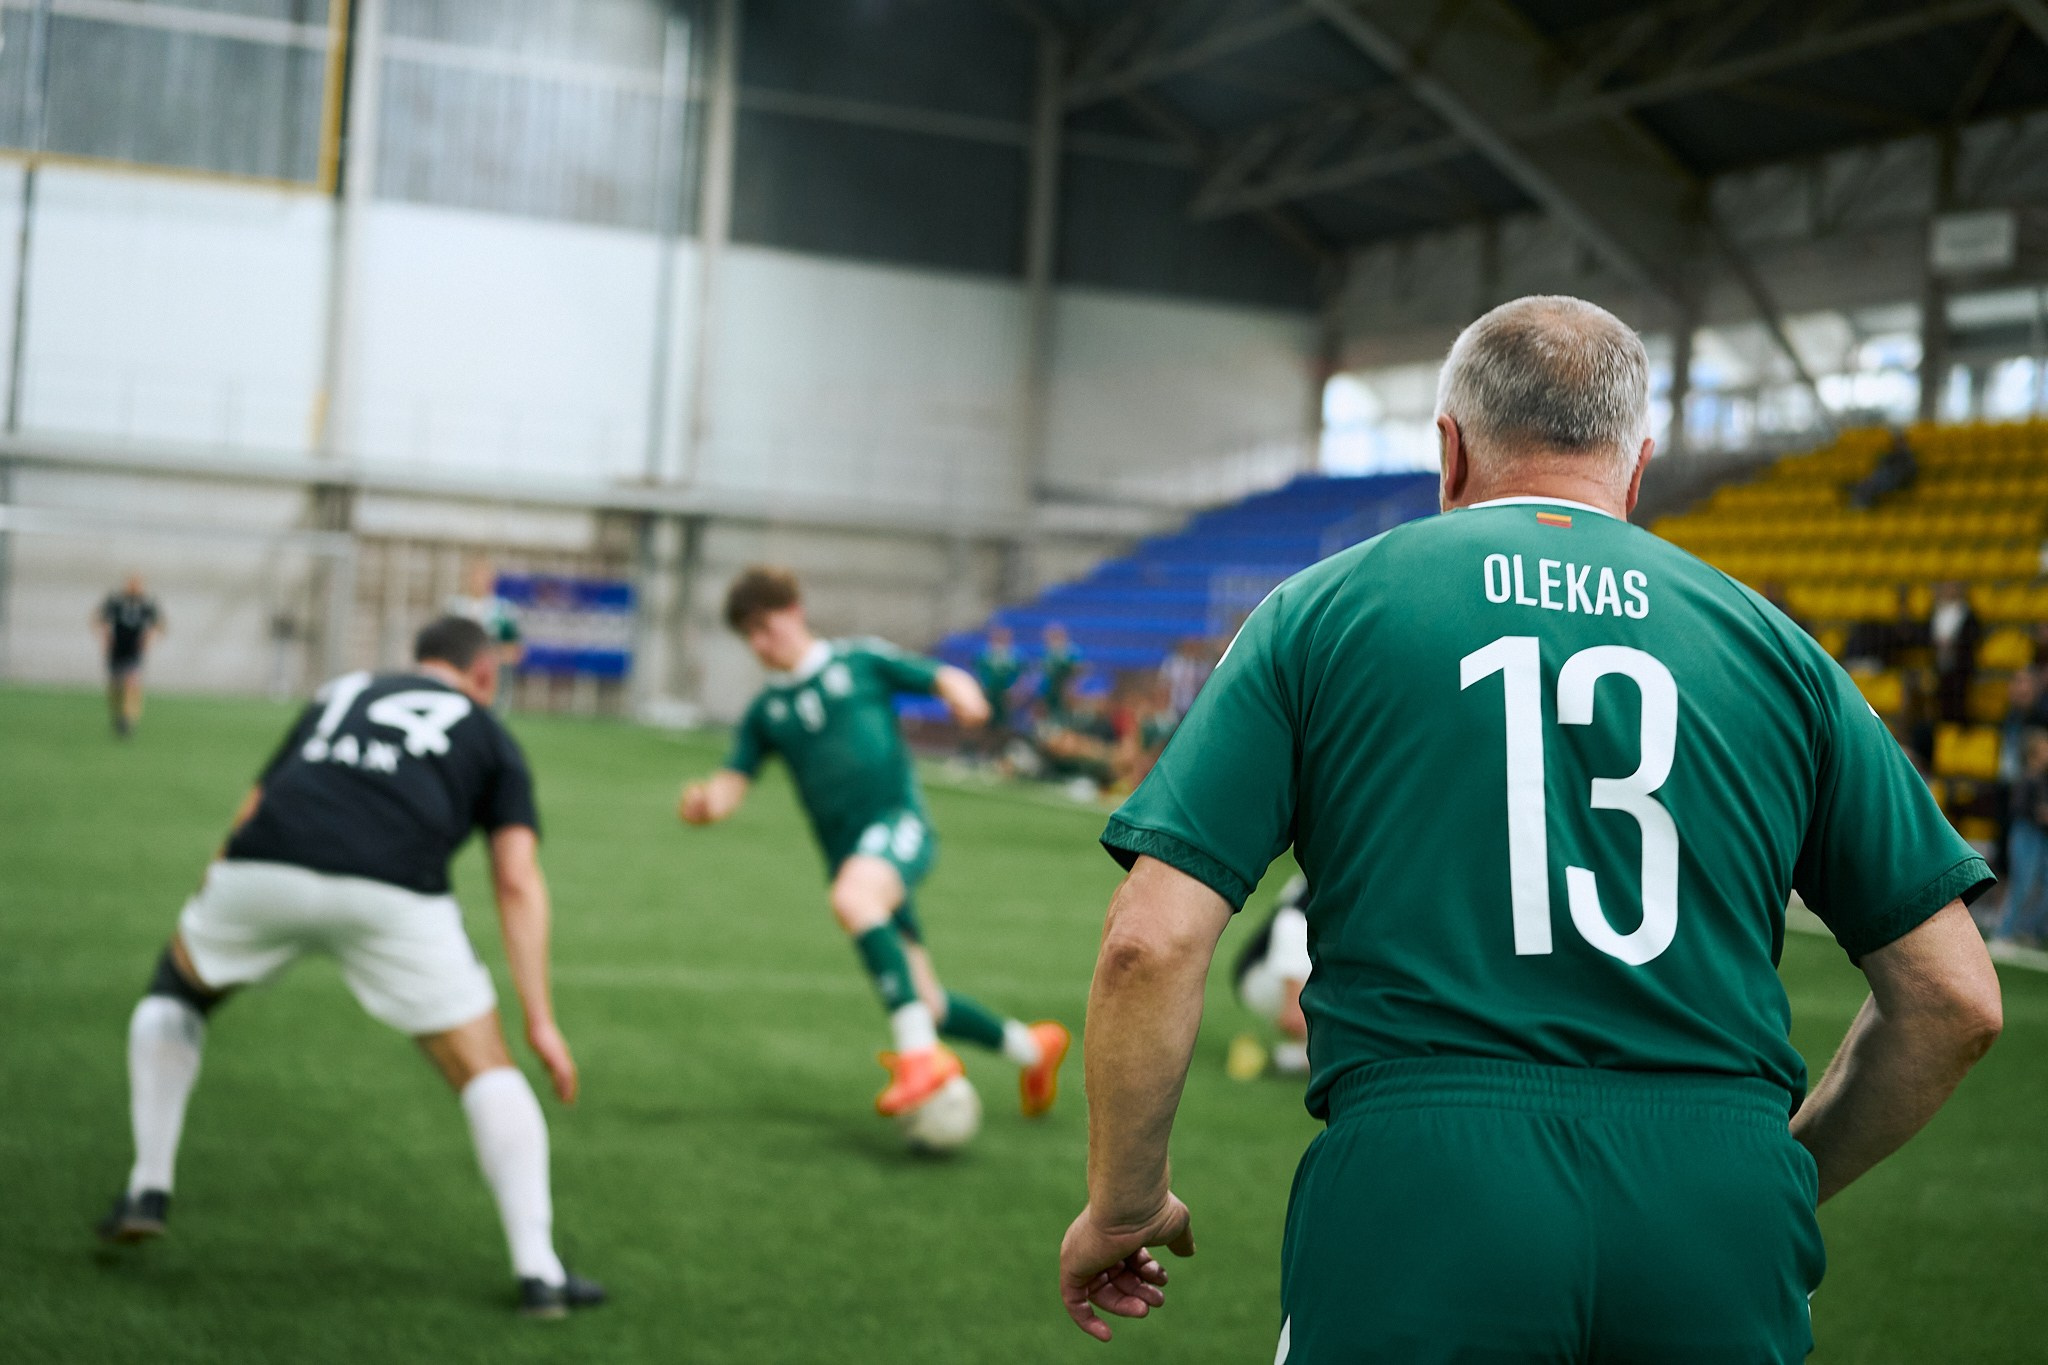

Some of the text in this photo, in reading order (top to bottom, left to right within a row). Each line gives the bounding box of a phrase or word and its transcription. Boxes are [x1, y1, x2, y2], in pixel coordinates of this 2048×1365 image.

[1483, 553, 1649, 620] OLEKAS
[315, 670, 472, 758] 14
[1459, 635, 1680, 966] 13
